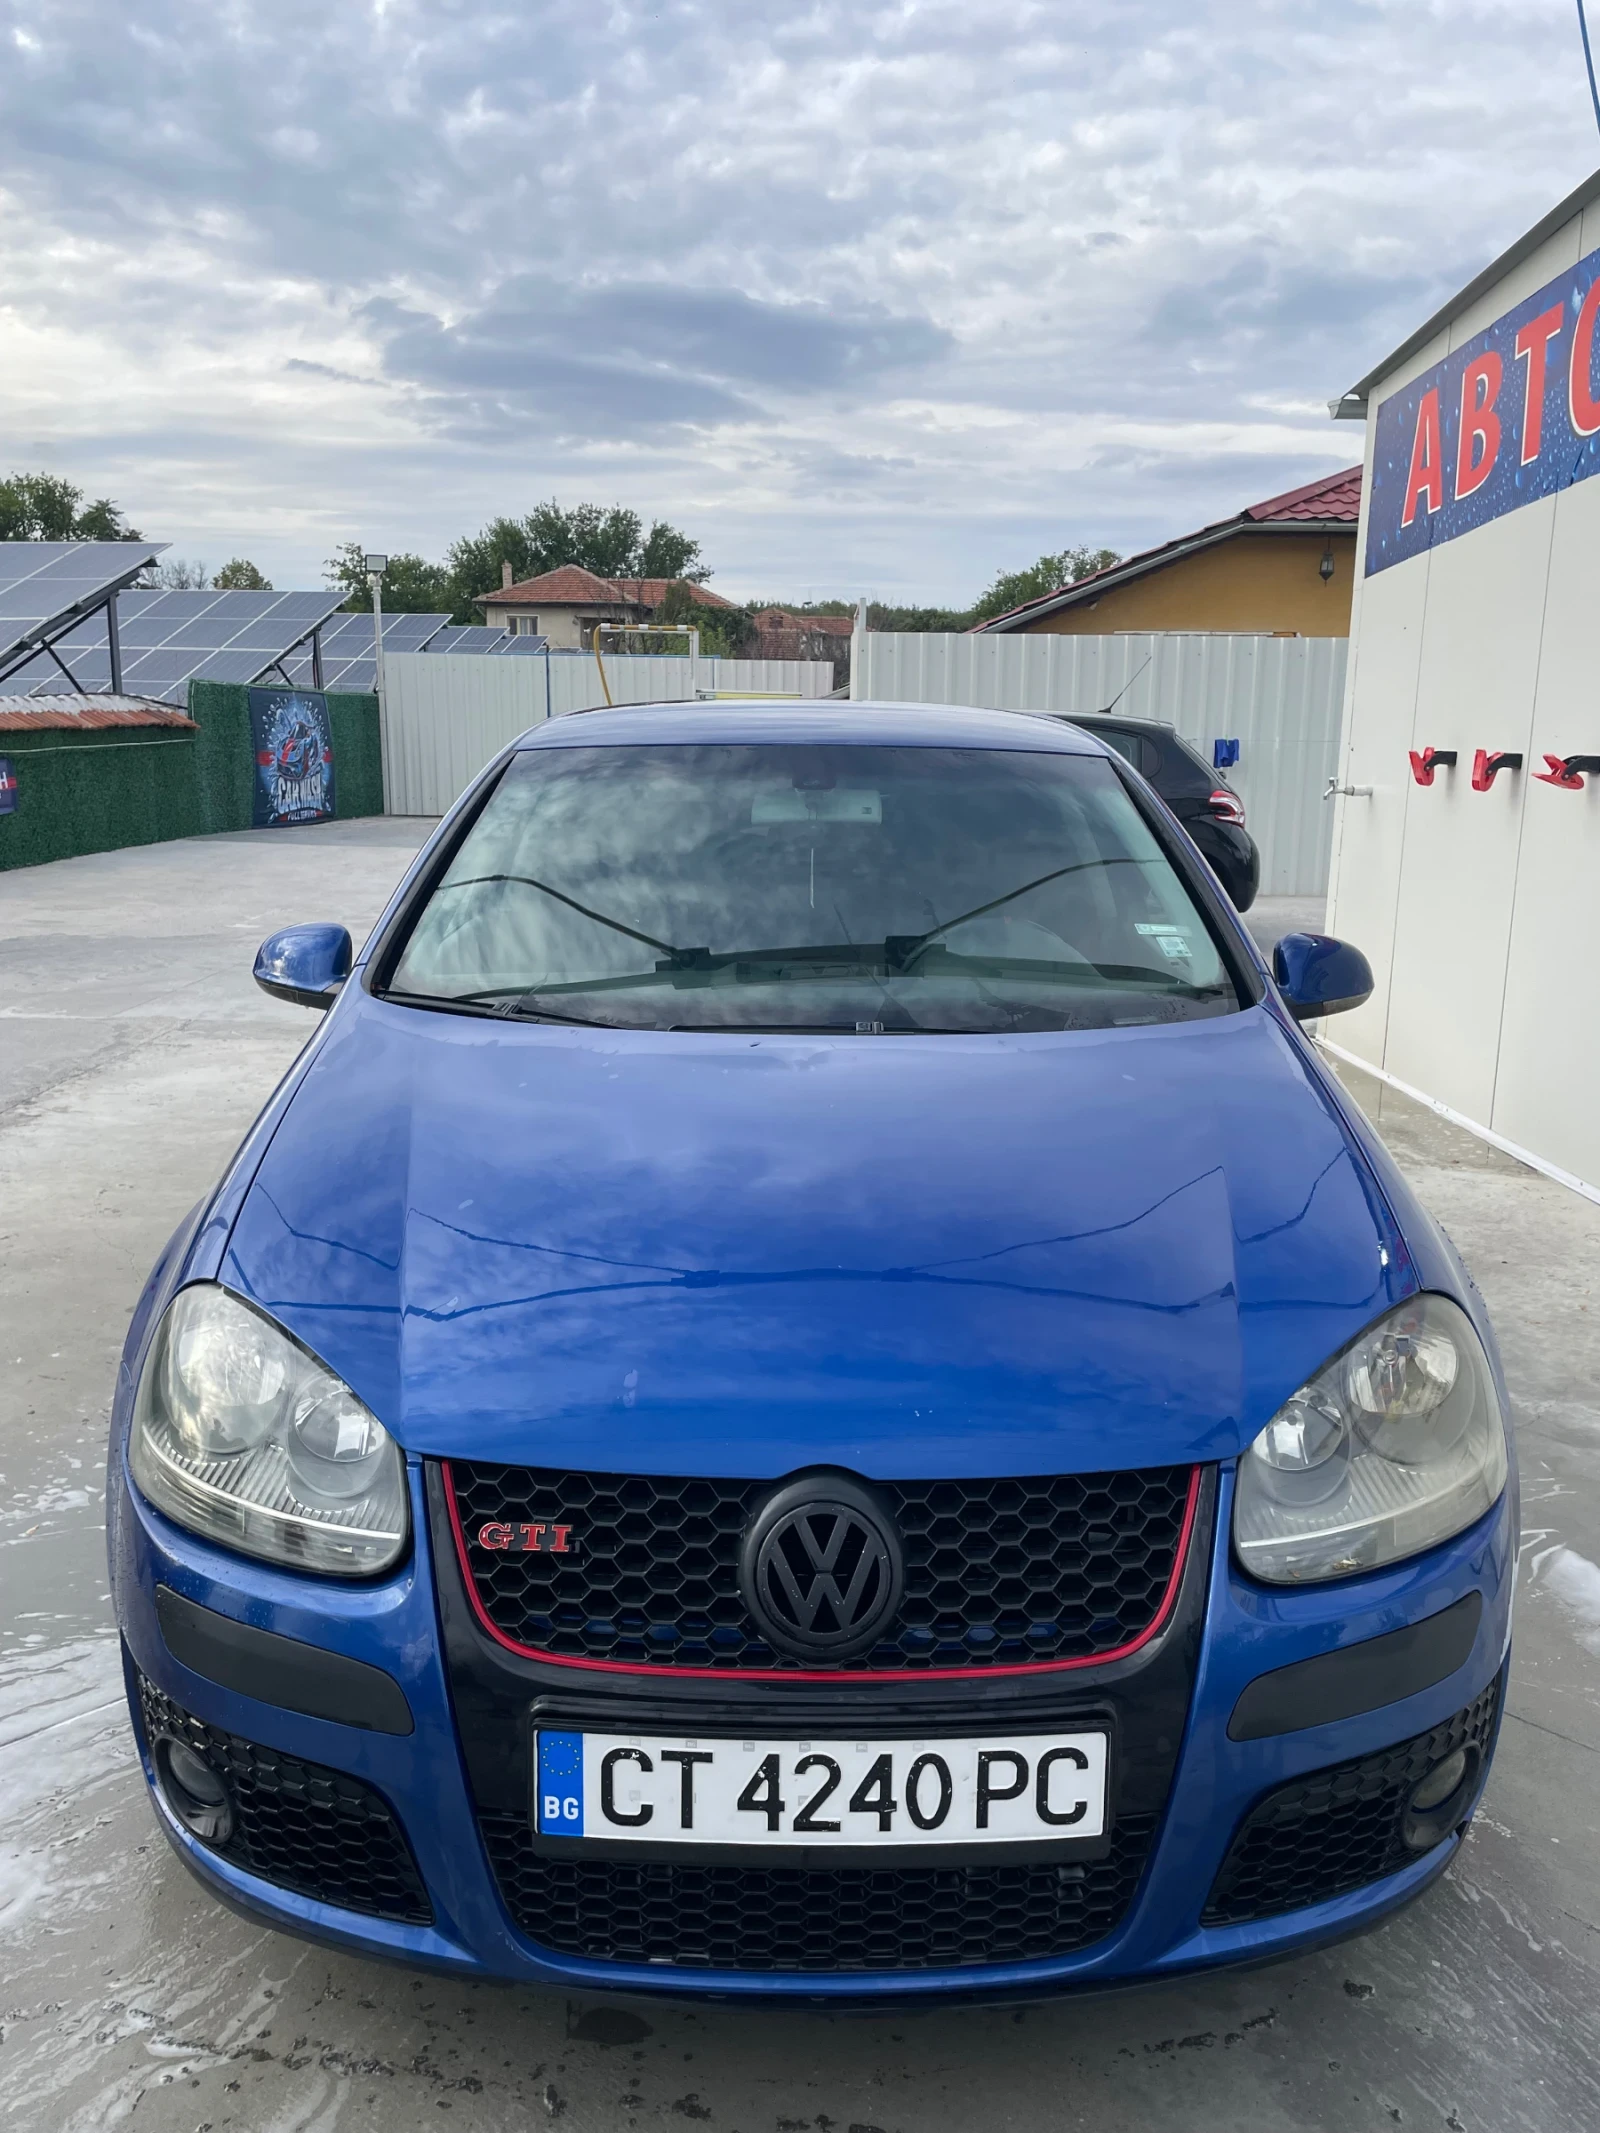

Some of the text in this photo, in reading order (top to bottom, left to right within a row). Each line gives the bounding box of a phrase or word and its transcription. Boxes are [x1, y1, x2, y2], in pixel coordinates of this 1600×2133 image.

[278, 776, 301, 814] CAR
[478, 1522, 572, 1552] GTI
[544, 1747, 1089, 1832] BG CT 4240 PC
